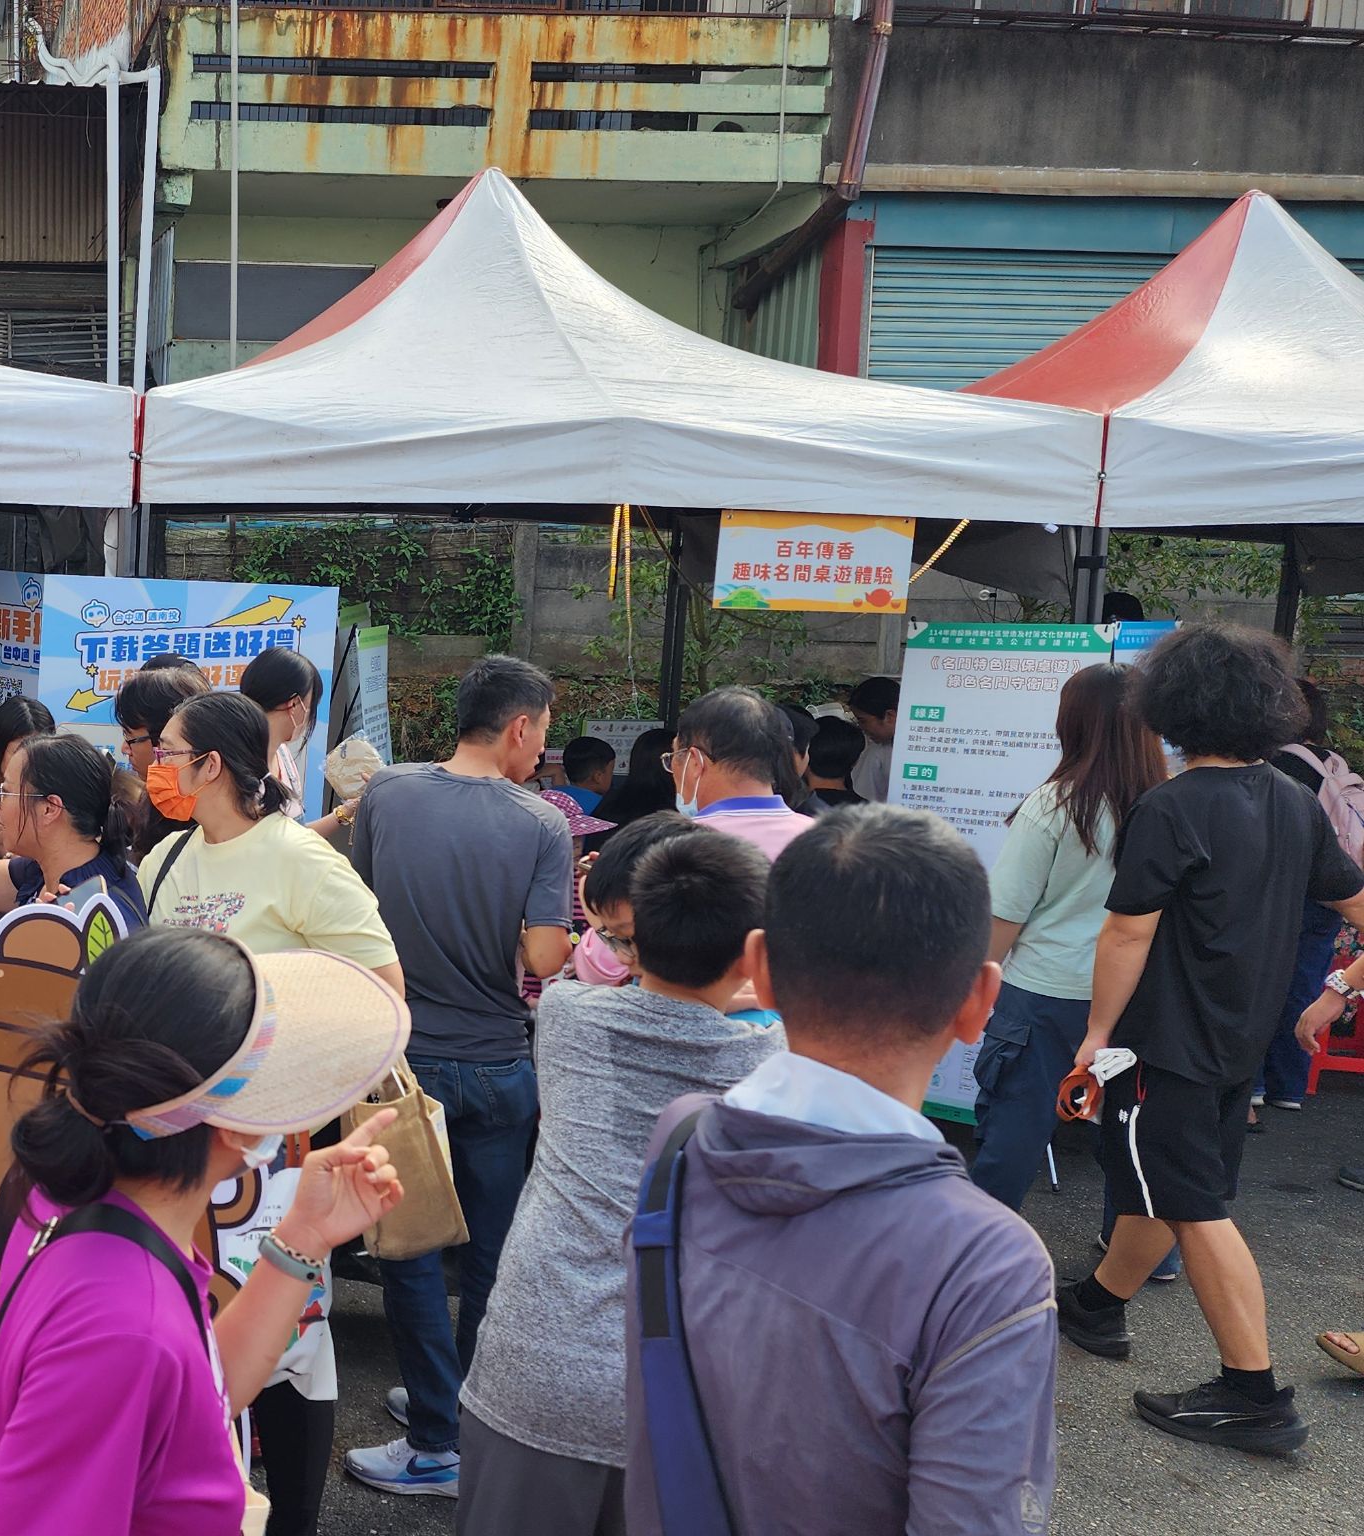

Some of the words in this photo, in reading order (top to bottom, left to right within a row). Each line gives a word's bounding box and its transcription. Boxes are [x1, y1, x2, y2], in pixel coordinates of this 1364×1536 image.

[776, 540, 855, 560] 百年傳香
[732, 562, 893, 585] 趣味名間桌遊體驗
[114, 611, 144, 624] 台中通
[81, 628, 295, 664] 下載答題送好禮
[908, 766, 933, 778] 目的
